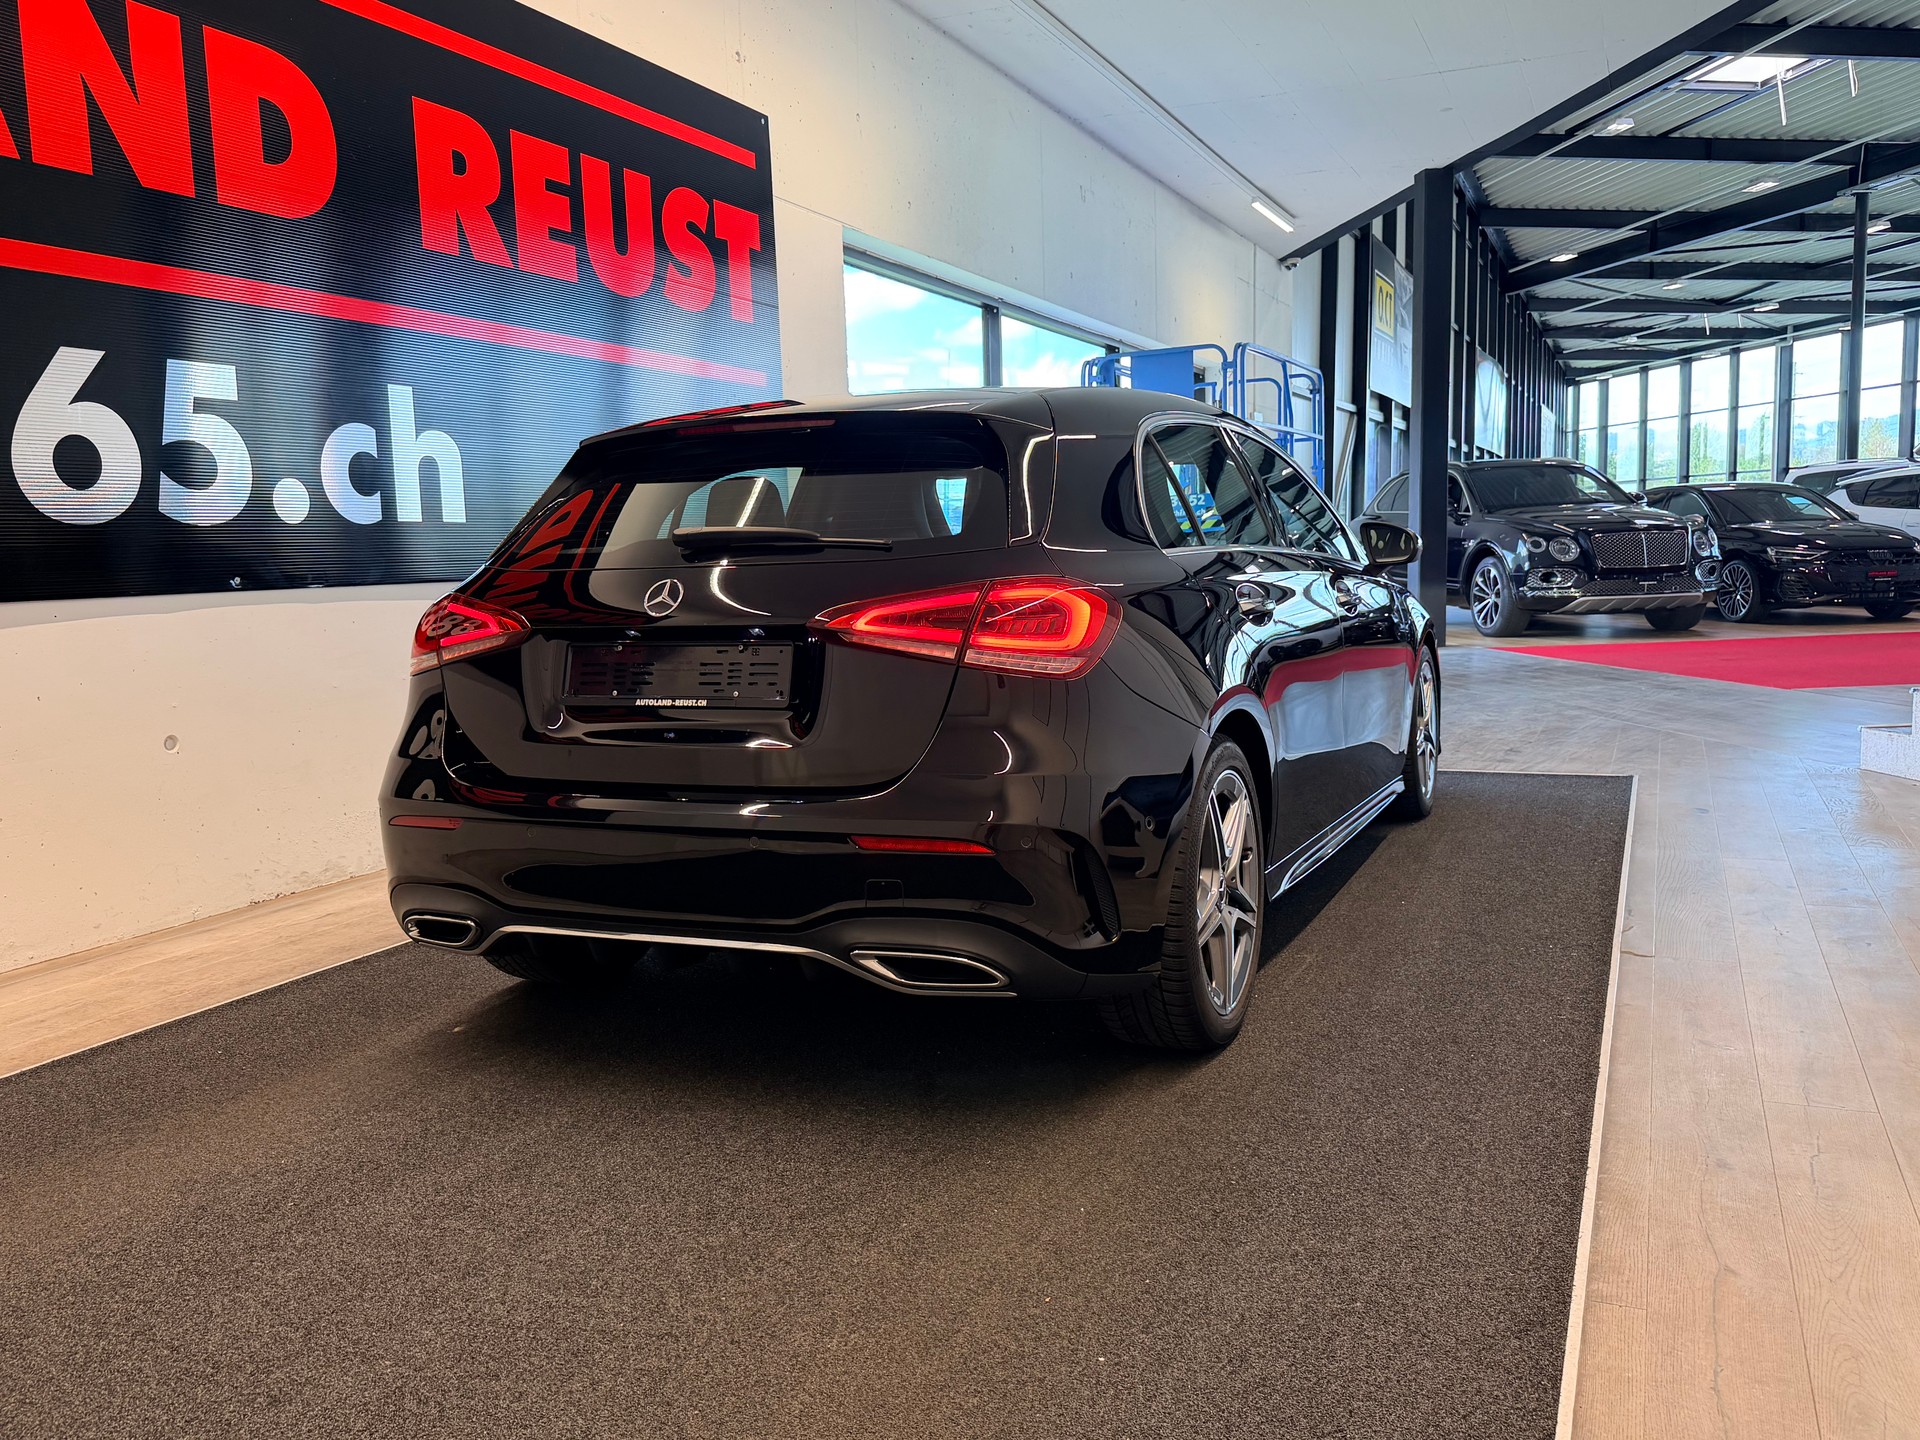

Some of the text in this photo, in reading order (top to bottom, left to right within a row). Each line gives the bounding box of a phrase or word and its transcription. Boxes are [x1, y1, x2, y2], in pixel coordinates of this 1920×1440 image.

[0, 0, 761, 323] ND REUST
[11, 346, 467, 526] 65.ch
[635, 699, 708, 707] AUTOLAND-REUST.CH
